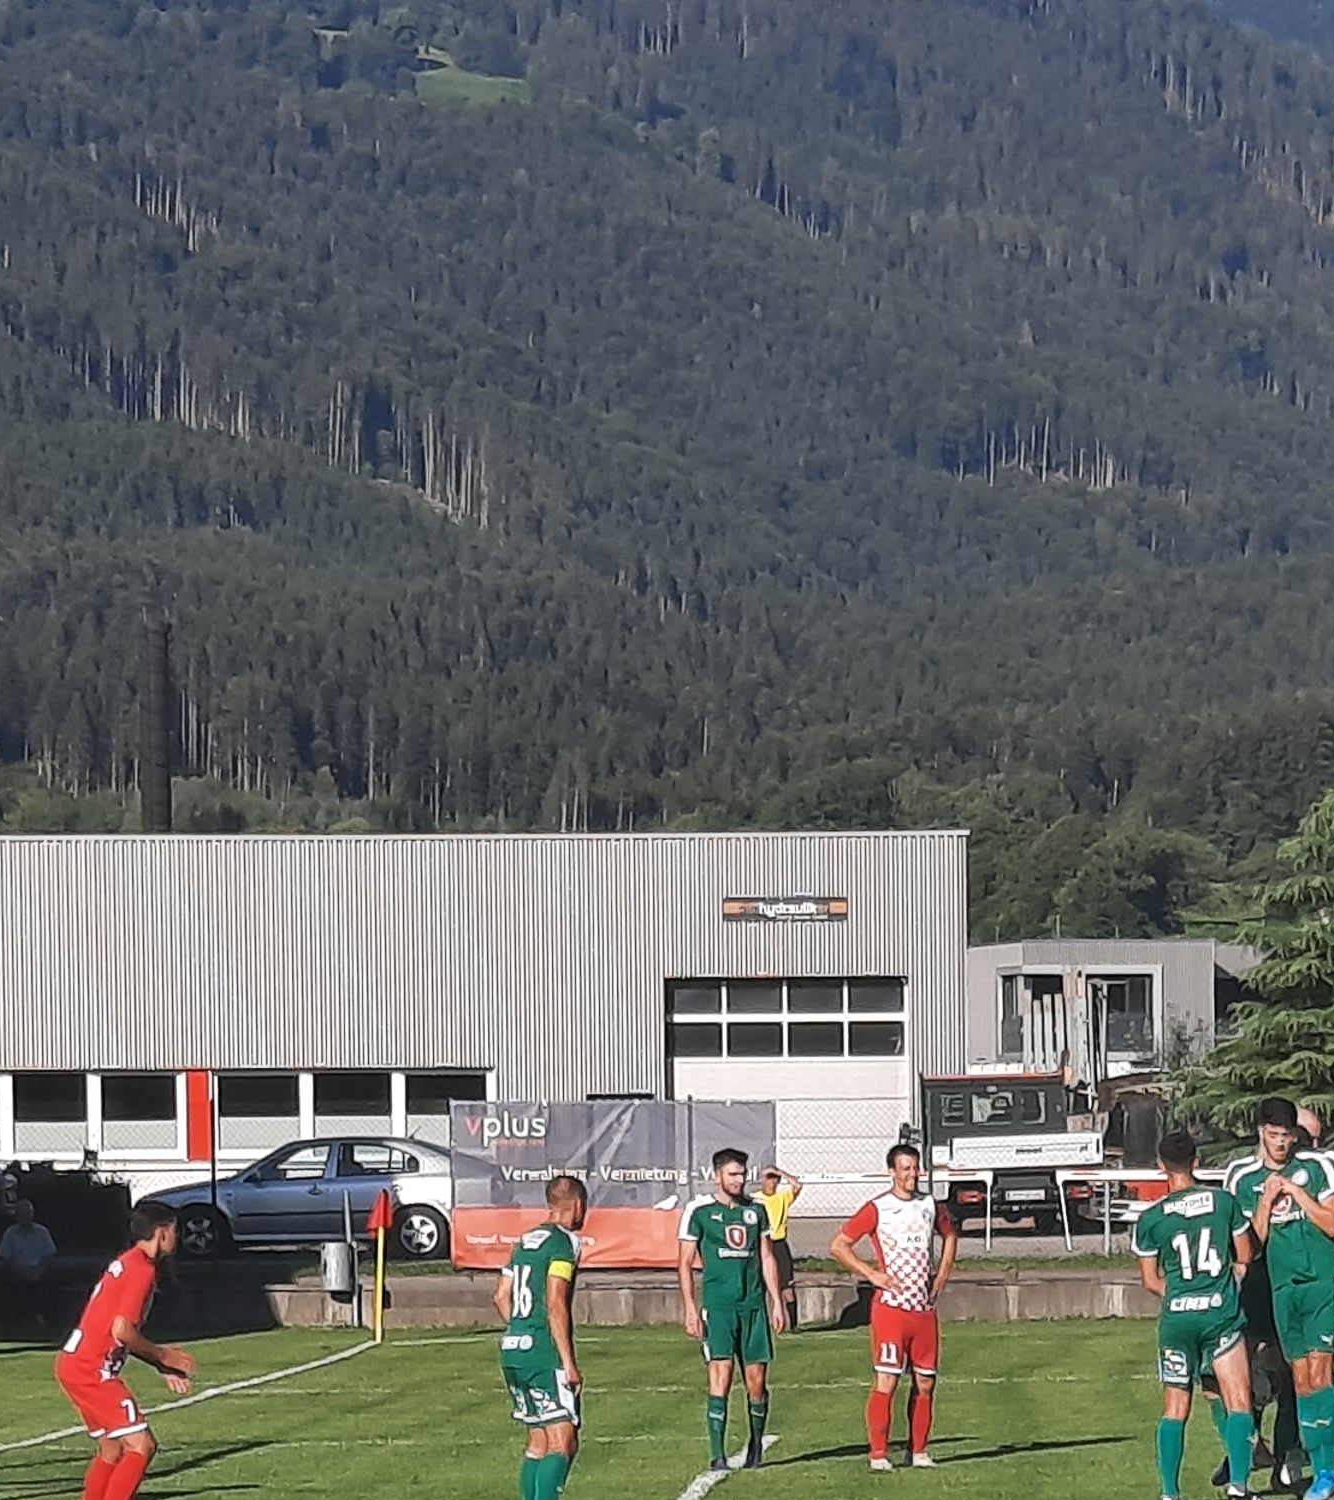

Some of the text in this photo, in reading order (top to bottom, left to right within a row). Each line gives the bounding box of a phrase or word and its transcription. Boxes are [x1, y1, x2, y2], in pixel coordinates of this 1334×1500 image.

[465, 1110, 547, 1148] vplus
[599, 1165, 687, 1184] Vermietung
[1171, 1228, 1222, 1280] 14
[512, 1264, 533, 1318] 16
[880, 1342, 898, 1364] 11
